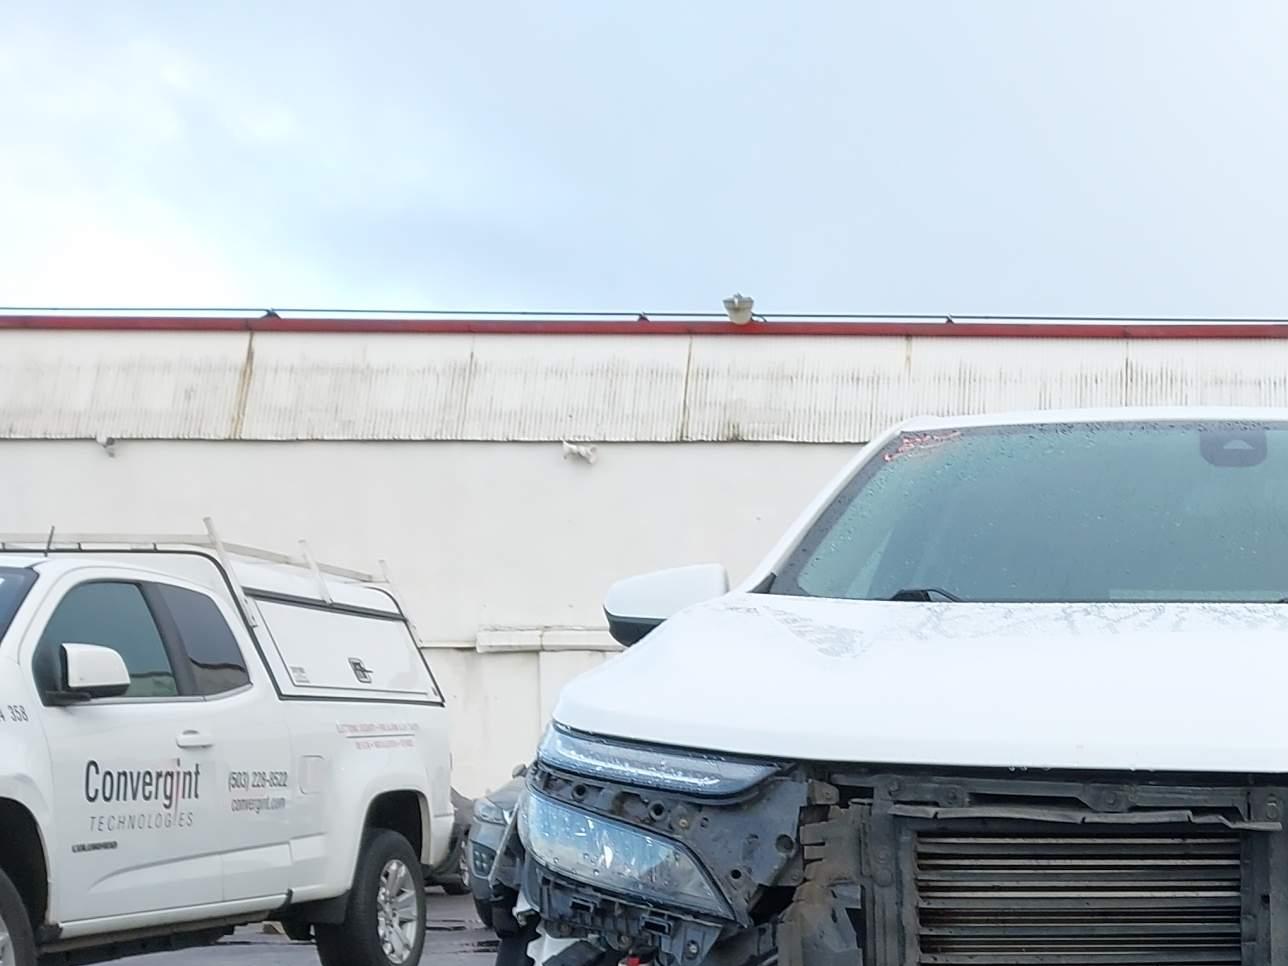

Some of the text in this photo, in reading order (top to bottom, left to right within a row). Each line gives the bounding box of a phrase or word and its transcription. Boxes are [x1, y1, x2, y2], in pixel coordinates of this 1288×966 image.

[8, 705, 29, 722] 358
[85, 758, 200, 814] Convergint
[89, 812, 195, 832] TECHNOLOGIES
